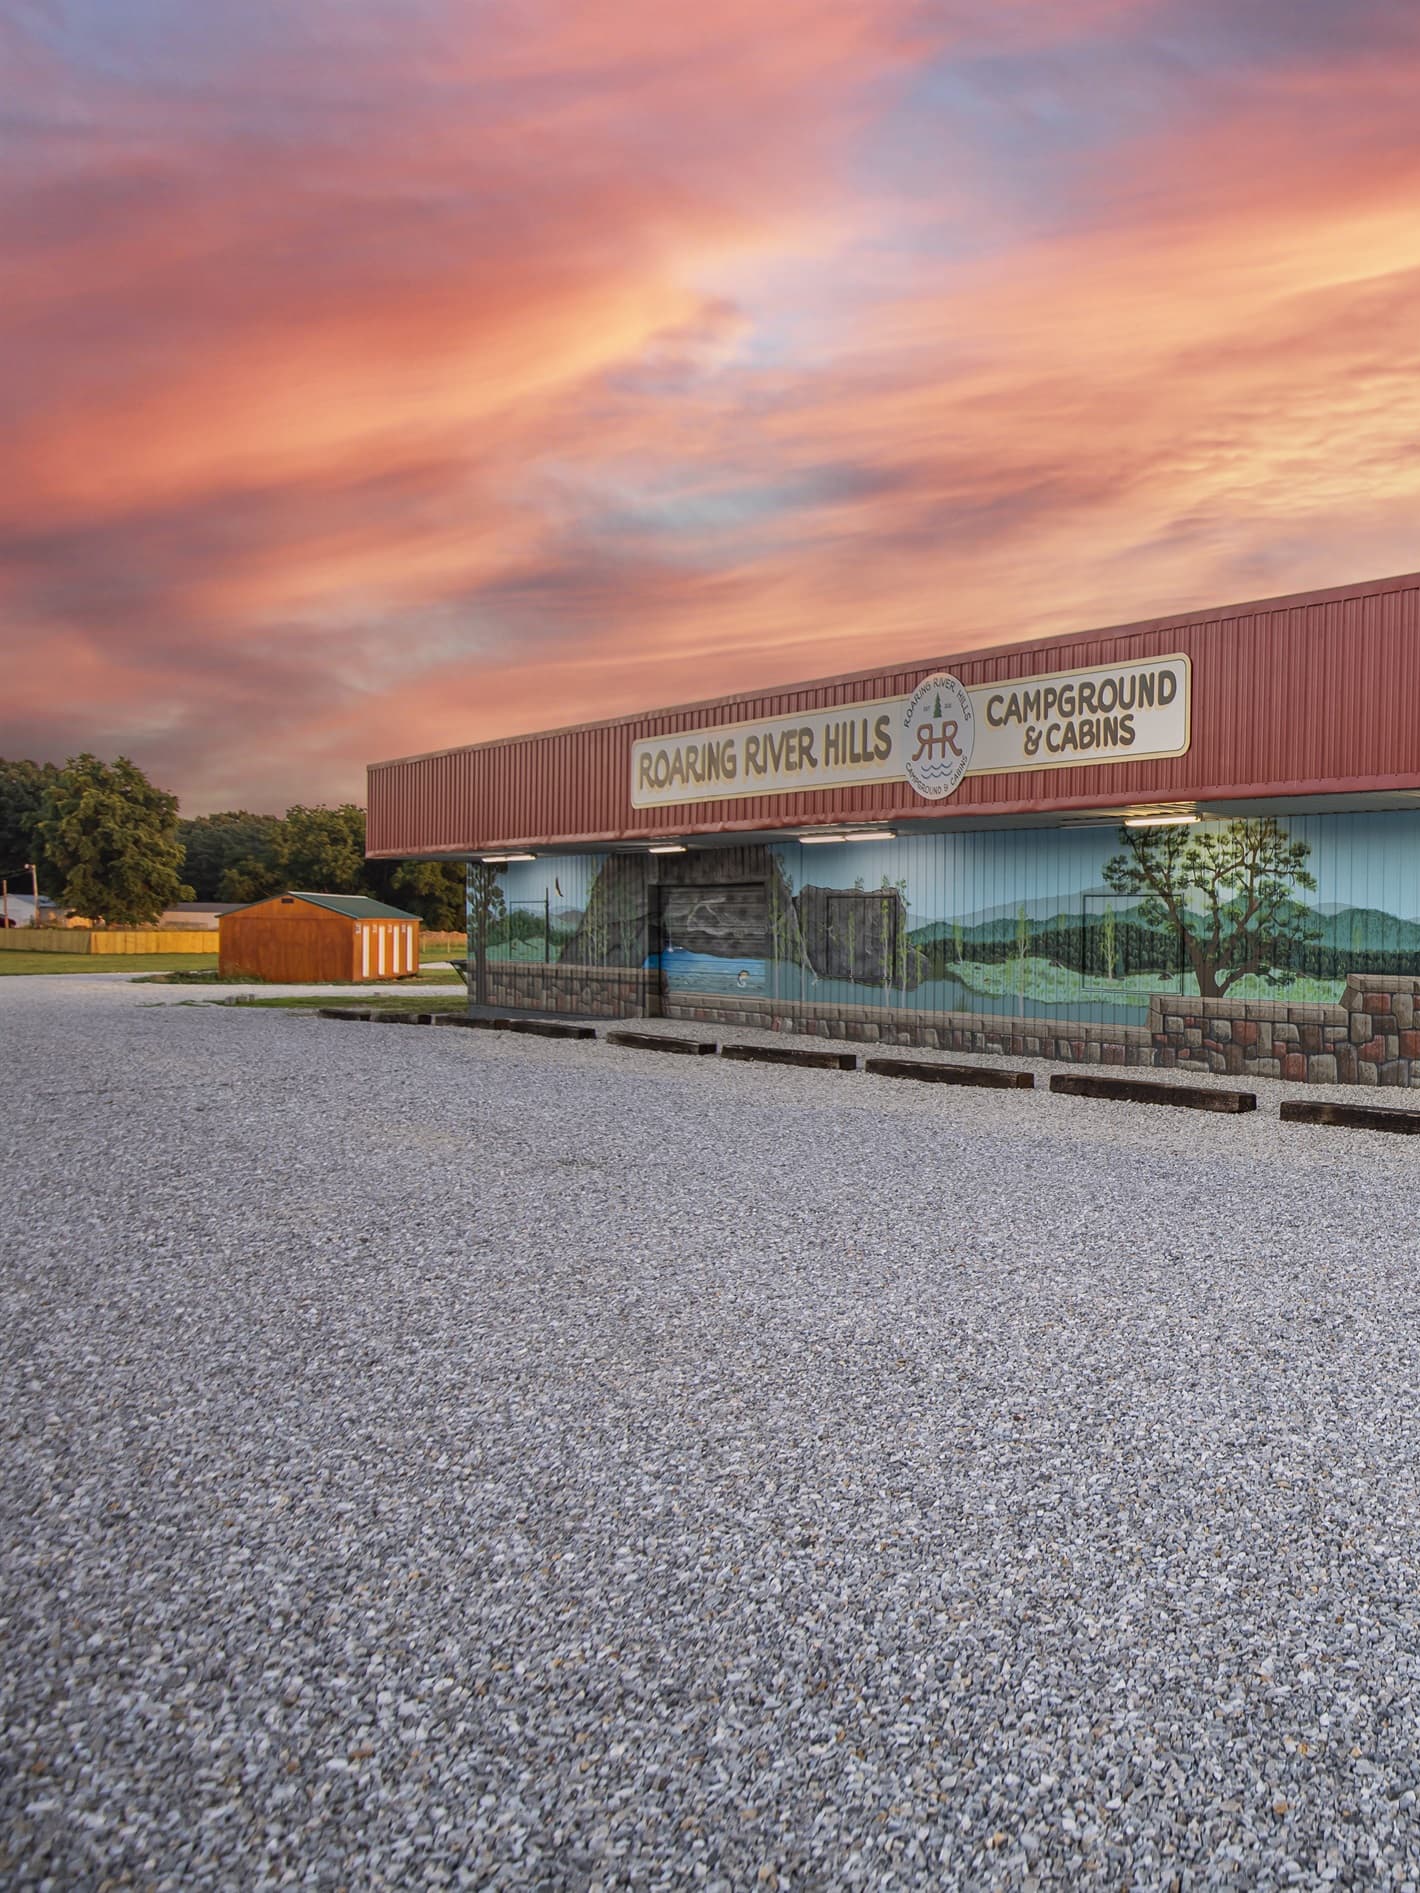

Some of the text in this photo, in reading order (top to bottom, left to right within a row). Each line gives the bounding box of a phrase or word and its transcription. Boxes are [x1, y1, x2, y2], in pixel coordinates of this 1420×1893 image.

[903, 678, 972, 728] ROARING RIVER HILLS
[987, 670, 1177, 727] CAMPGROUND
[639, 715, 892, 790] ROARING RIVER HILLS
[1024, 714, 1136, 755] & CABINS
[905, 762, 942, 795] CAMPGROUND
[950, 755, 968, 786] CABINS
